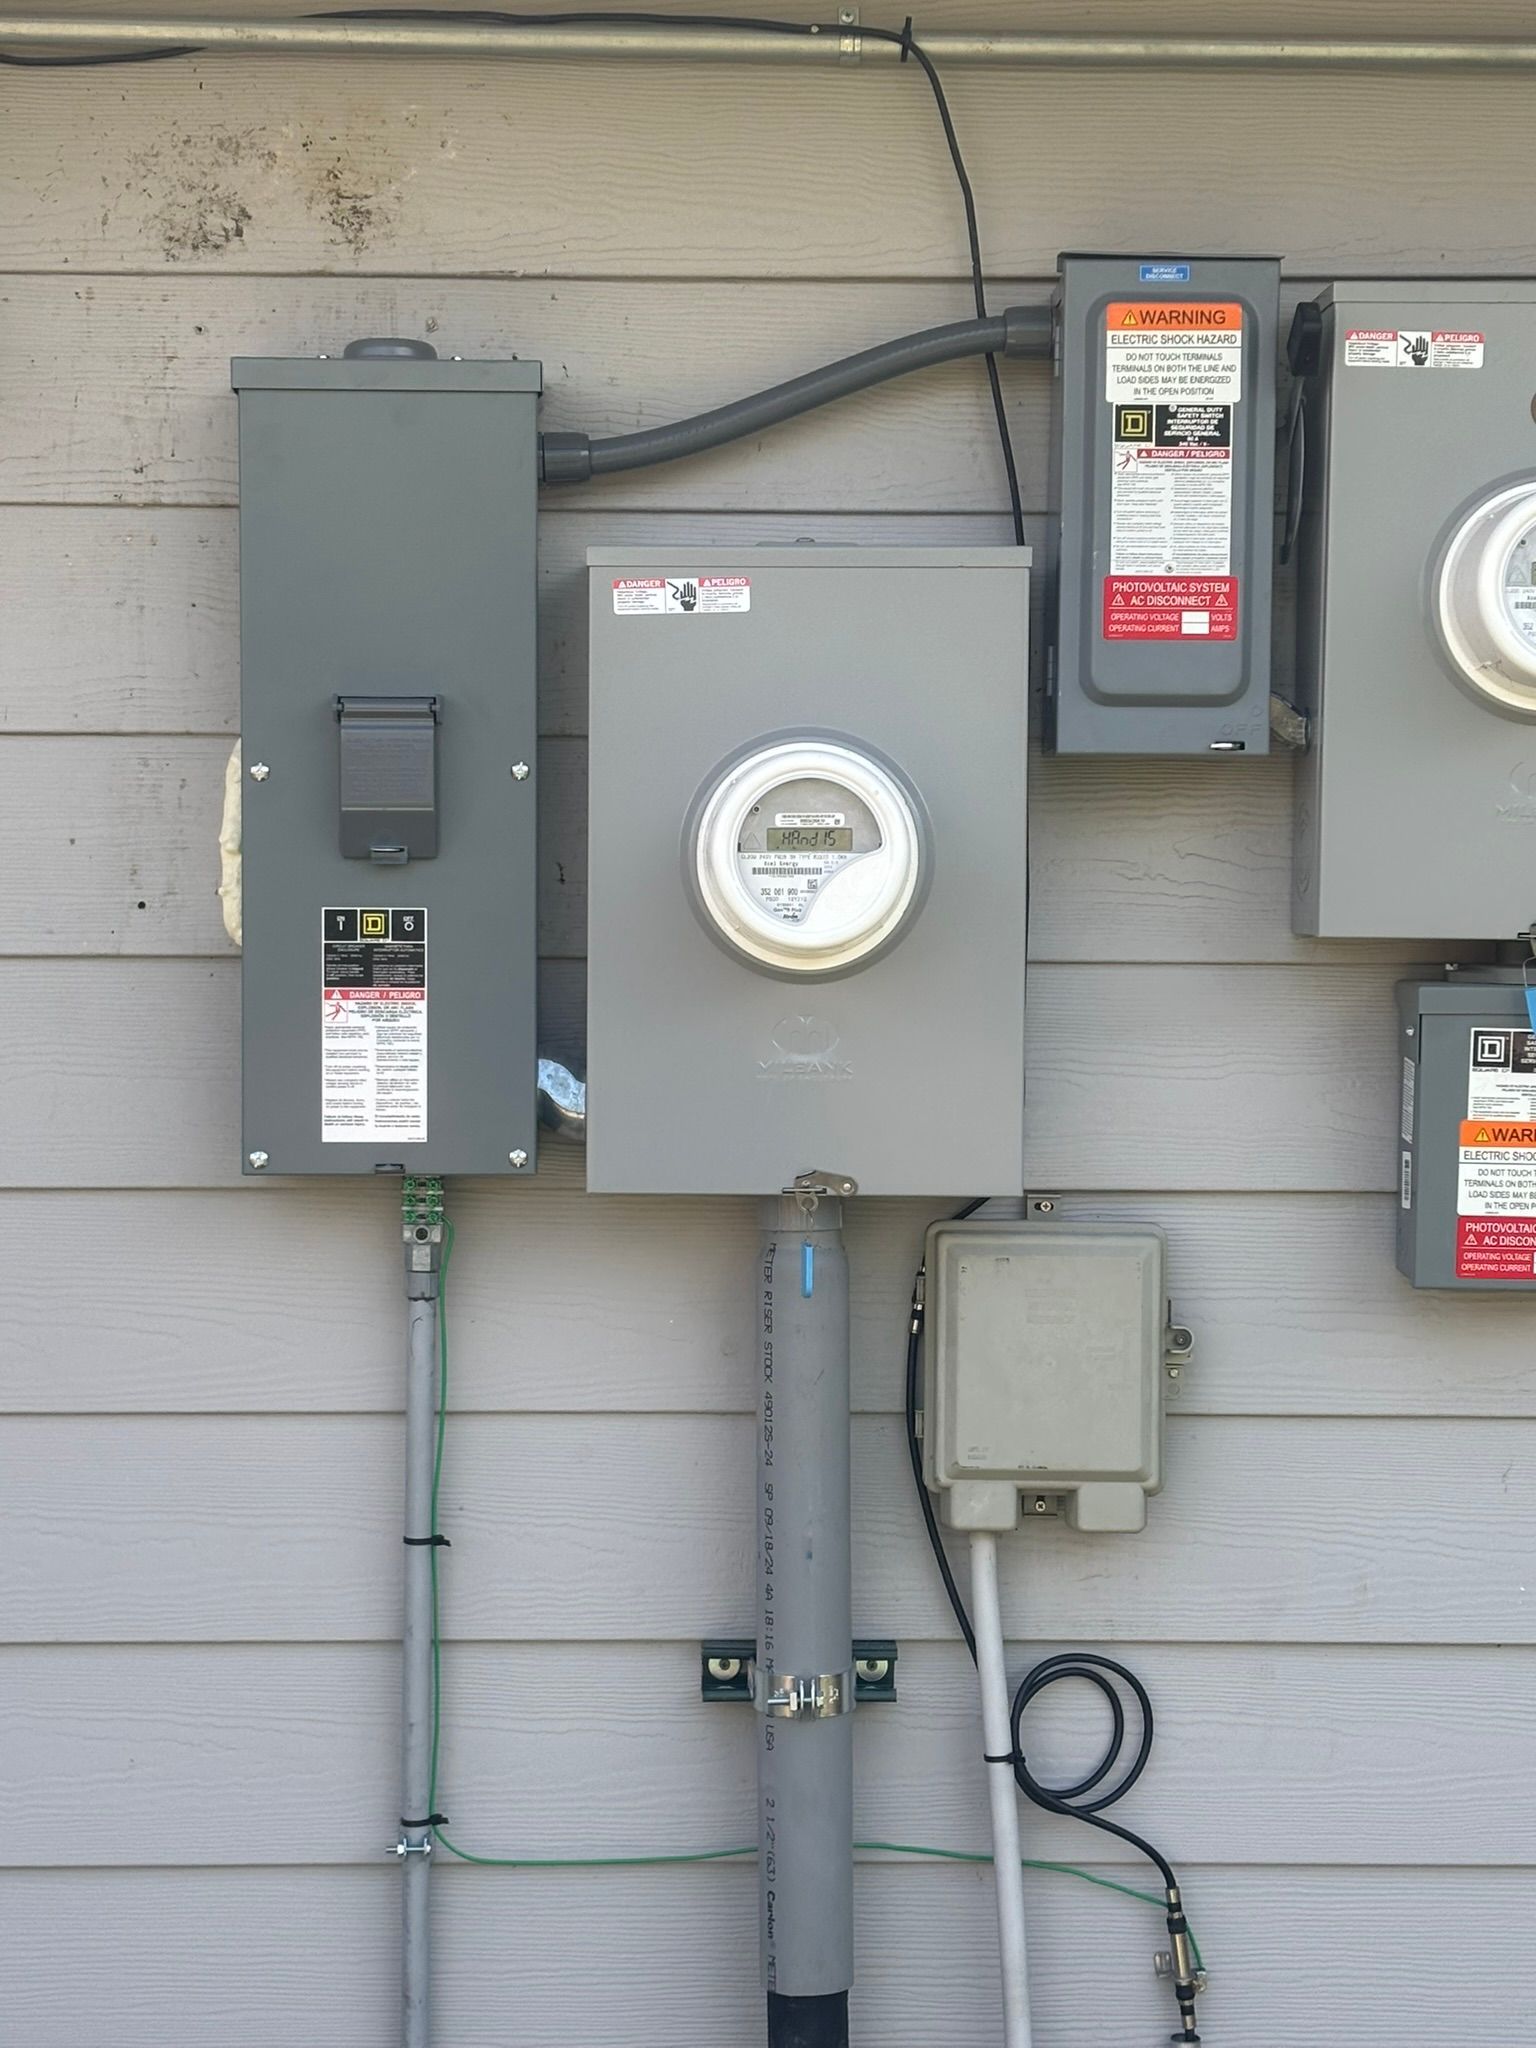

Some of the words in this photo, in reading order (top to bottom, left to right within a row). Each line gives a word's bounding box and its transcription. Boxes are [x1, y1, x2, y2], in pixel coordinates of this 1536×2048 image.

[1140, 310, 1226, 324] WARNING
[1112, 334, 1157, 344] ELECTRIC
[1160, 334, 1195, 344] SHOCK
[1197, 334, 1237, 344] HAZARD
[1358, 332, 1394, 340] DANGER
[1444, 334, 1480, 342] PELIGRO
[1112, 364, 1152, 372] TERMINALS
[1154, 364, 1164, 372] ON
[1166, 364, 1185, 372] BOTH
[1188, 364, 1202, 372] THE
[1204, 364, 1219, 372] LINE
[1222, 364, 1236, 372] AND
[1117, 376, 1136, 384] LOAD
[1138, 376, 1159, 384] SIDES
[1162, 376, 1176, 384] MAY
[1179, 376, 1188, 384] BE
[1190, 376, 1231, 384] ENERGIZED
[626, 580, 661, 588] DANGER
[712, 578, 746, 586] PELIGRO
[1112, 582, 1187, 592] PHOTOVOLTAIC
[1189, 582, 1230, 592] SYSTEM
[1130, 596, 1145, 606] AC
[1146, 596, 1211, 606] DISCONNECT
[1110, 613, 1148, 622] OPERATING
[1150, 613, 1180, 622] VOLTAGE
[1211, 613, 1232, 622] VOLTS
[1108, 624, 1147, 632] OPERATING
[1148, 624, 1180, 632] CURRENT
[1210, 624, 1230, 632] AMPS
[350, 991, 380, 999] DANGER
[382, 991, 386, 999] /
[389, 991, 421, 999] PELIGRO
[1492, 1128, 1536, 1142] WAR
[1464, 1151, 1510, 1160] ELECTRIC
[1464, 1180, 1504, 1188] TERMINALS
[1505, 1180, 1516, 1188] ON
[1468, 1190, 1488, 1198] LOAD
[1494, 1202, 1508, 1210] THE
[1509, 1202, 1529, 1210] OPEN
[1483, 1236, 1497, 1246] AC
[1463, 1252, 1500, 1260] OPERATING
[1502, 1253, 1532, 1261] VOLTAGE
[764, 1242, 777, 1284] METER
[1461, 1264, 1499, 1272] OPERATING
[1500, 1264, 1532, 1272] CURRENT
[764, 1290, 773, 1334] RISER
[764, 1341, 774, 1383] STOCK
[764, 1483, 774, 1501] SP
[764, 1508, 774, 1575] 09/18/24
[765, 1584, 774, 1601] 4A
[765, 1610, 774, 1650] 18:16
[766, 1725, 774, 1751] USA
[766, 1798, 775, 1808] 2
